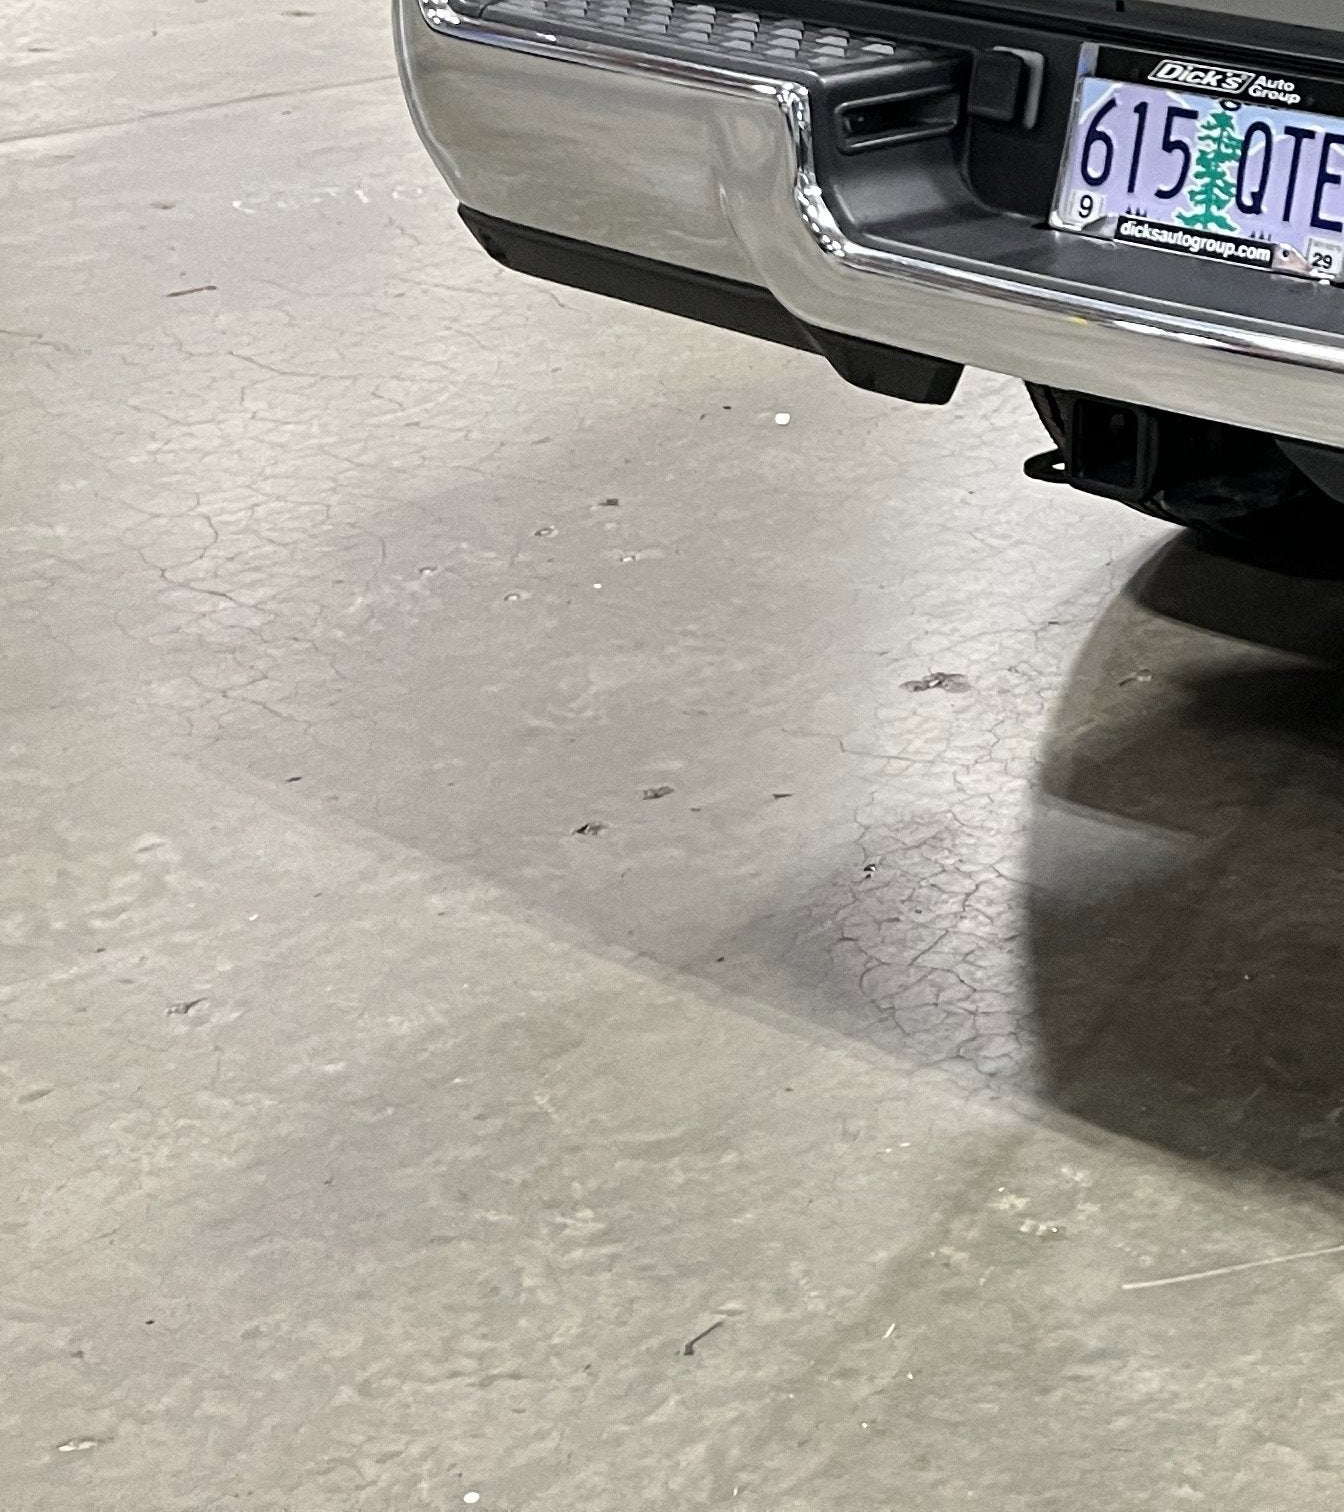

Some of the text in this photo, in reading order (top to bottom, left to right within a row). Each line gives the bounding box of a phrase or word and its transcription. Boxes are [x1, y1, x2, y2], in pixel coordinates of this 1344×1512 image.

[1156, 62, 1243, 90] Dick's
[1254, 75, 1295, 91] Auto
[1248, 85, 1302, 106] Group
[1080, 97, 1199, 200] 615
[1079, 194, 1093, 218] 9
[1119, 219, 1272, 263] dicksautogroup.com
[1312, 252, 1334, 270] 29
